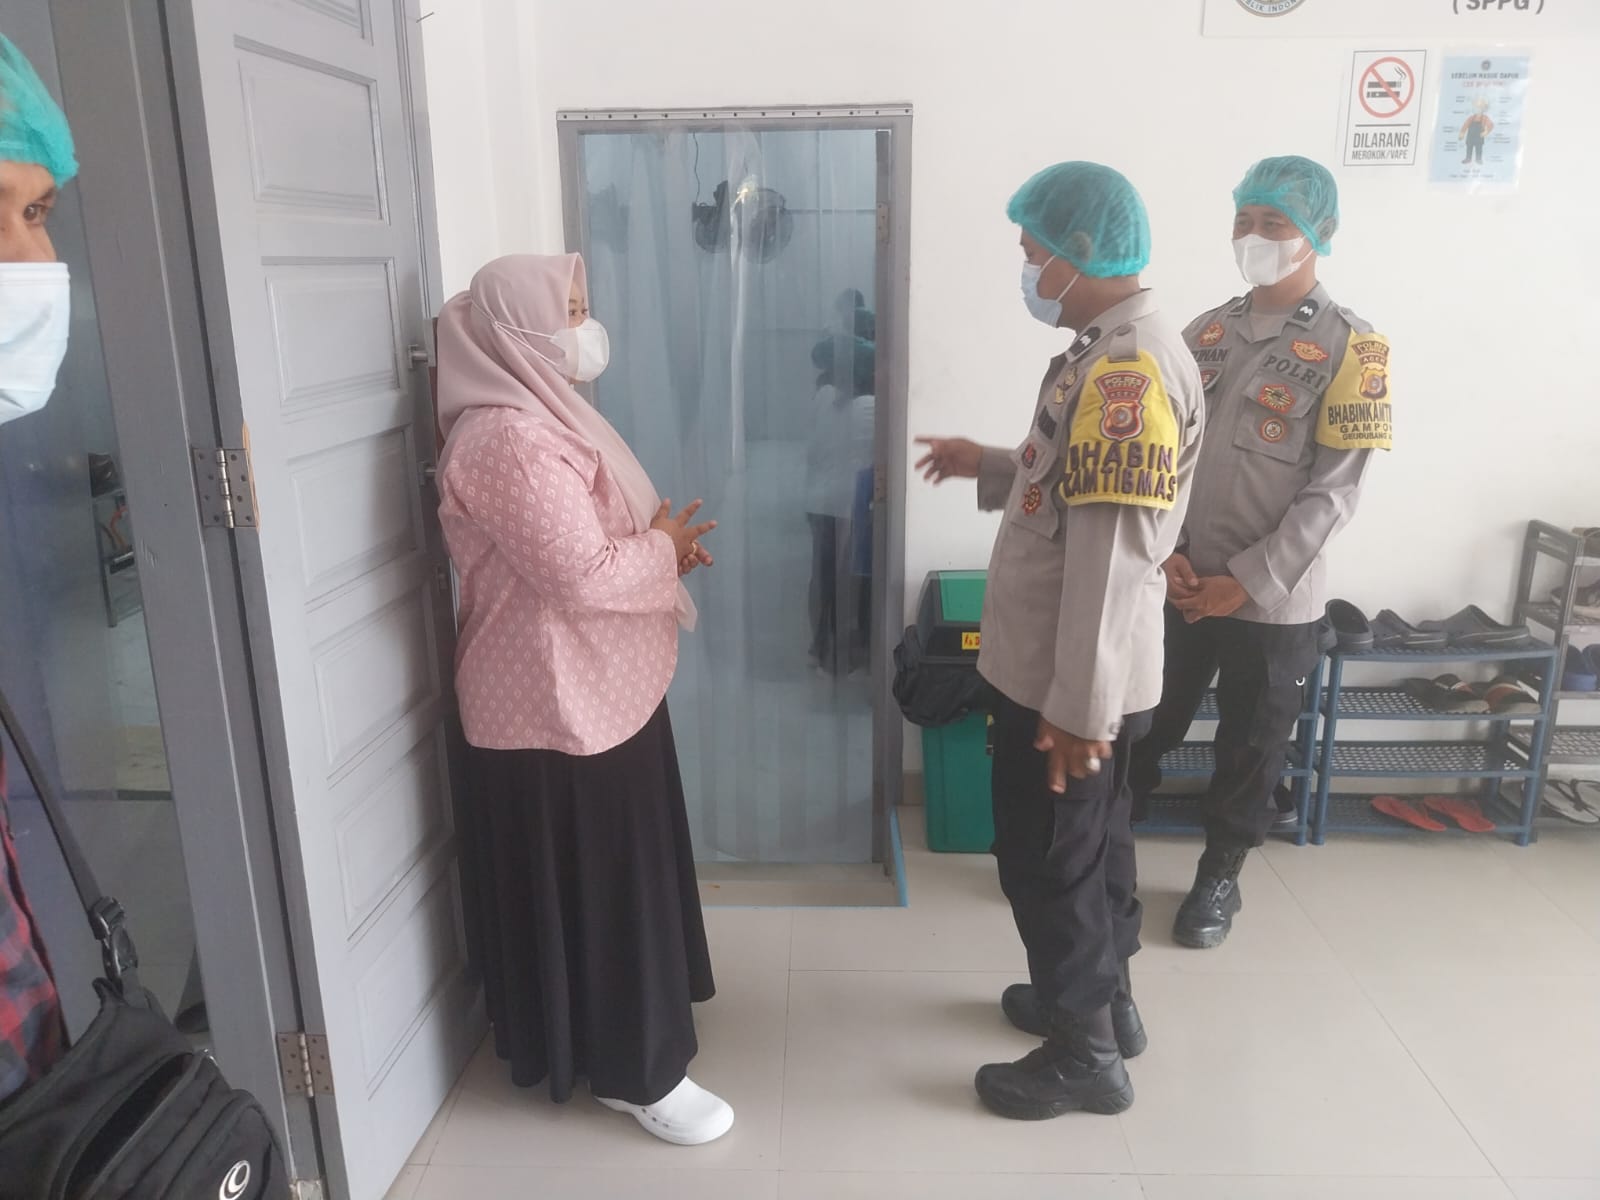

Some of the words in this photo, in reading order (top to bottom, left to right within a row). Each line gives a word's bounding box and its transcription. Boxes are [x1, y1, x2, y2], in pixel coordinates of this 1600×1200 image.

[1353, 132, 1410, 148] DILARANG
[1351, 149, 1409, 160] MEROKOK/VAPE
[1263, 354, 1328, 389] POLRI
[1064, 467, 1177, 502] KAMTIBMAS
